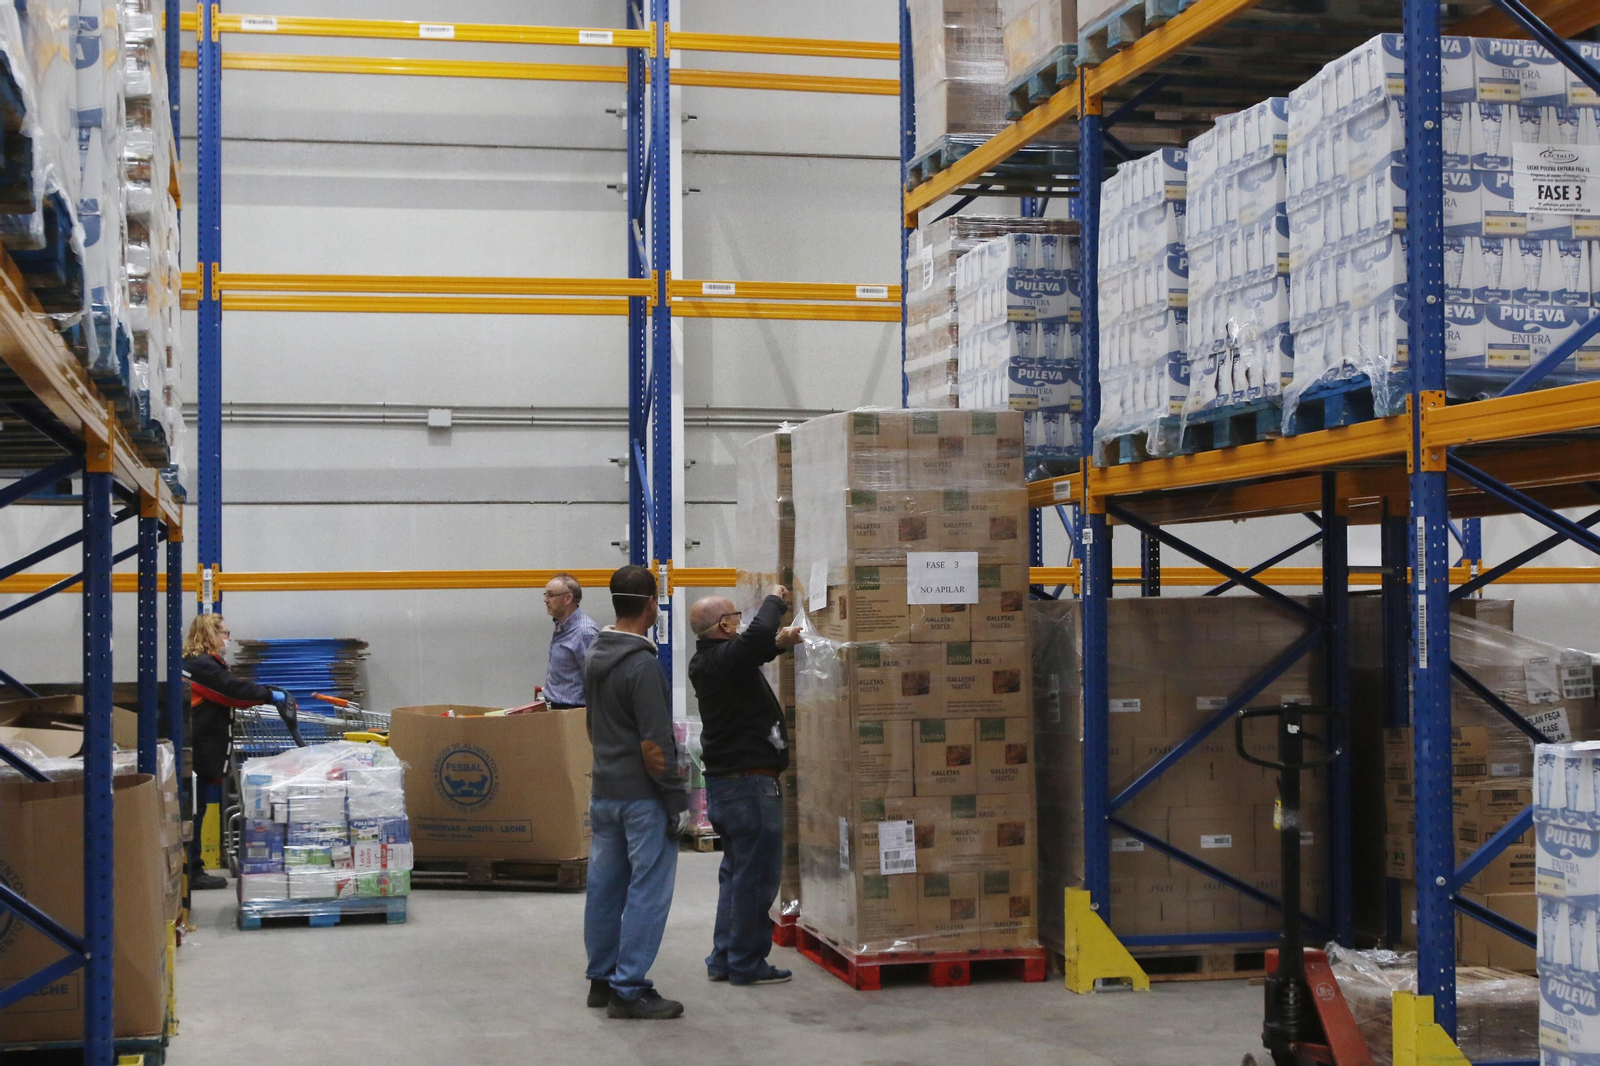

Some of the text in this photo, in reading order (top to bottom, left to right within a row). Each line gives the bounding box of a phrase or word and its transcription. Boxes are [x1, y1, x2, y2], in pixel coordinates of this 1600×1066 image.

[1489, 41, 1555, 59] PULEVA
[1502, 68, 1541, 80] ENTERA
[1443, 172, 1472, 186] EVA
[1538, 185, 1582, 201] FASE 3
[1015, 280, 1061, 292] PULEVA
[1023, 299, 1050, 307] ENTERA
[1445, 305, 1476, 319] EVA
[1500, 306, 1566, 322] PULEVA
[1512, 334, 1551, 344] ENTERA
[1017, 368, 1063, 380] PULEVA
[1025, 387, 1053, 395] ENTERA
[926, 561, 959, 569] FASE 3
[1544, 711, 1561, 722] FEGA
[1543, 723, 1559, 734] FASE
[1547, 733, 1566, 742] PILAR
[463, 743, 499, 774] ALIMENTOS
[446, 763, 483, 772] FESBAL
[417, 823, 461, 832] CONSERVAS
[500, 825, 527, 833] LECHE
[1545, 828, 1592, 850] PULEVA
[1551, 858, 1581, 875] ENTERA
[1547, 979, 1596, 1008] PULEVA
[1554, 1012, 1584, 1032] ENTERA
